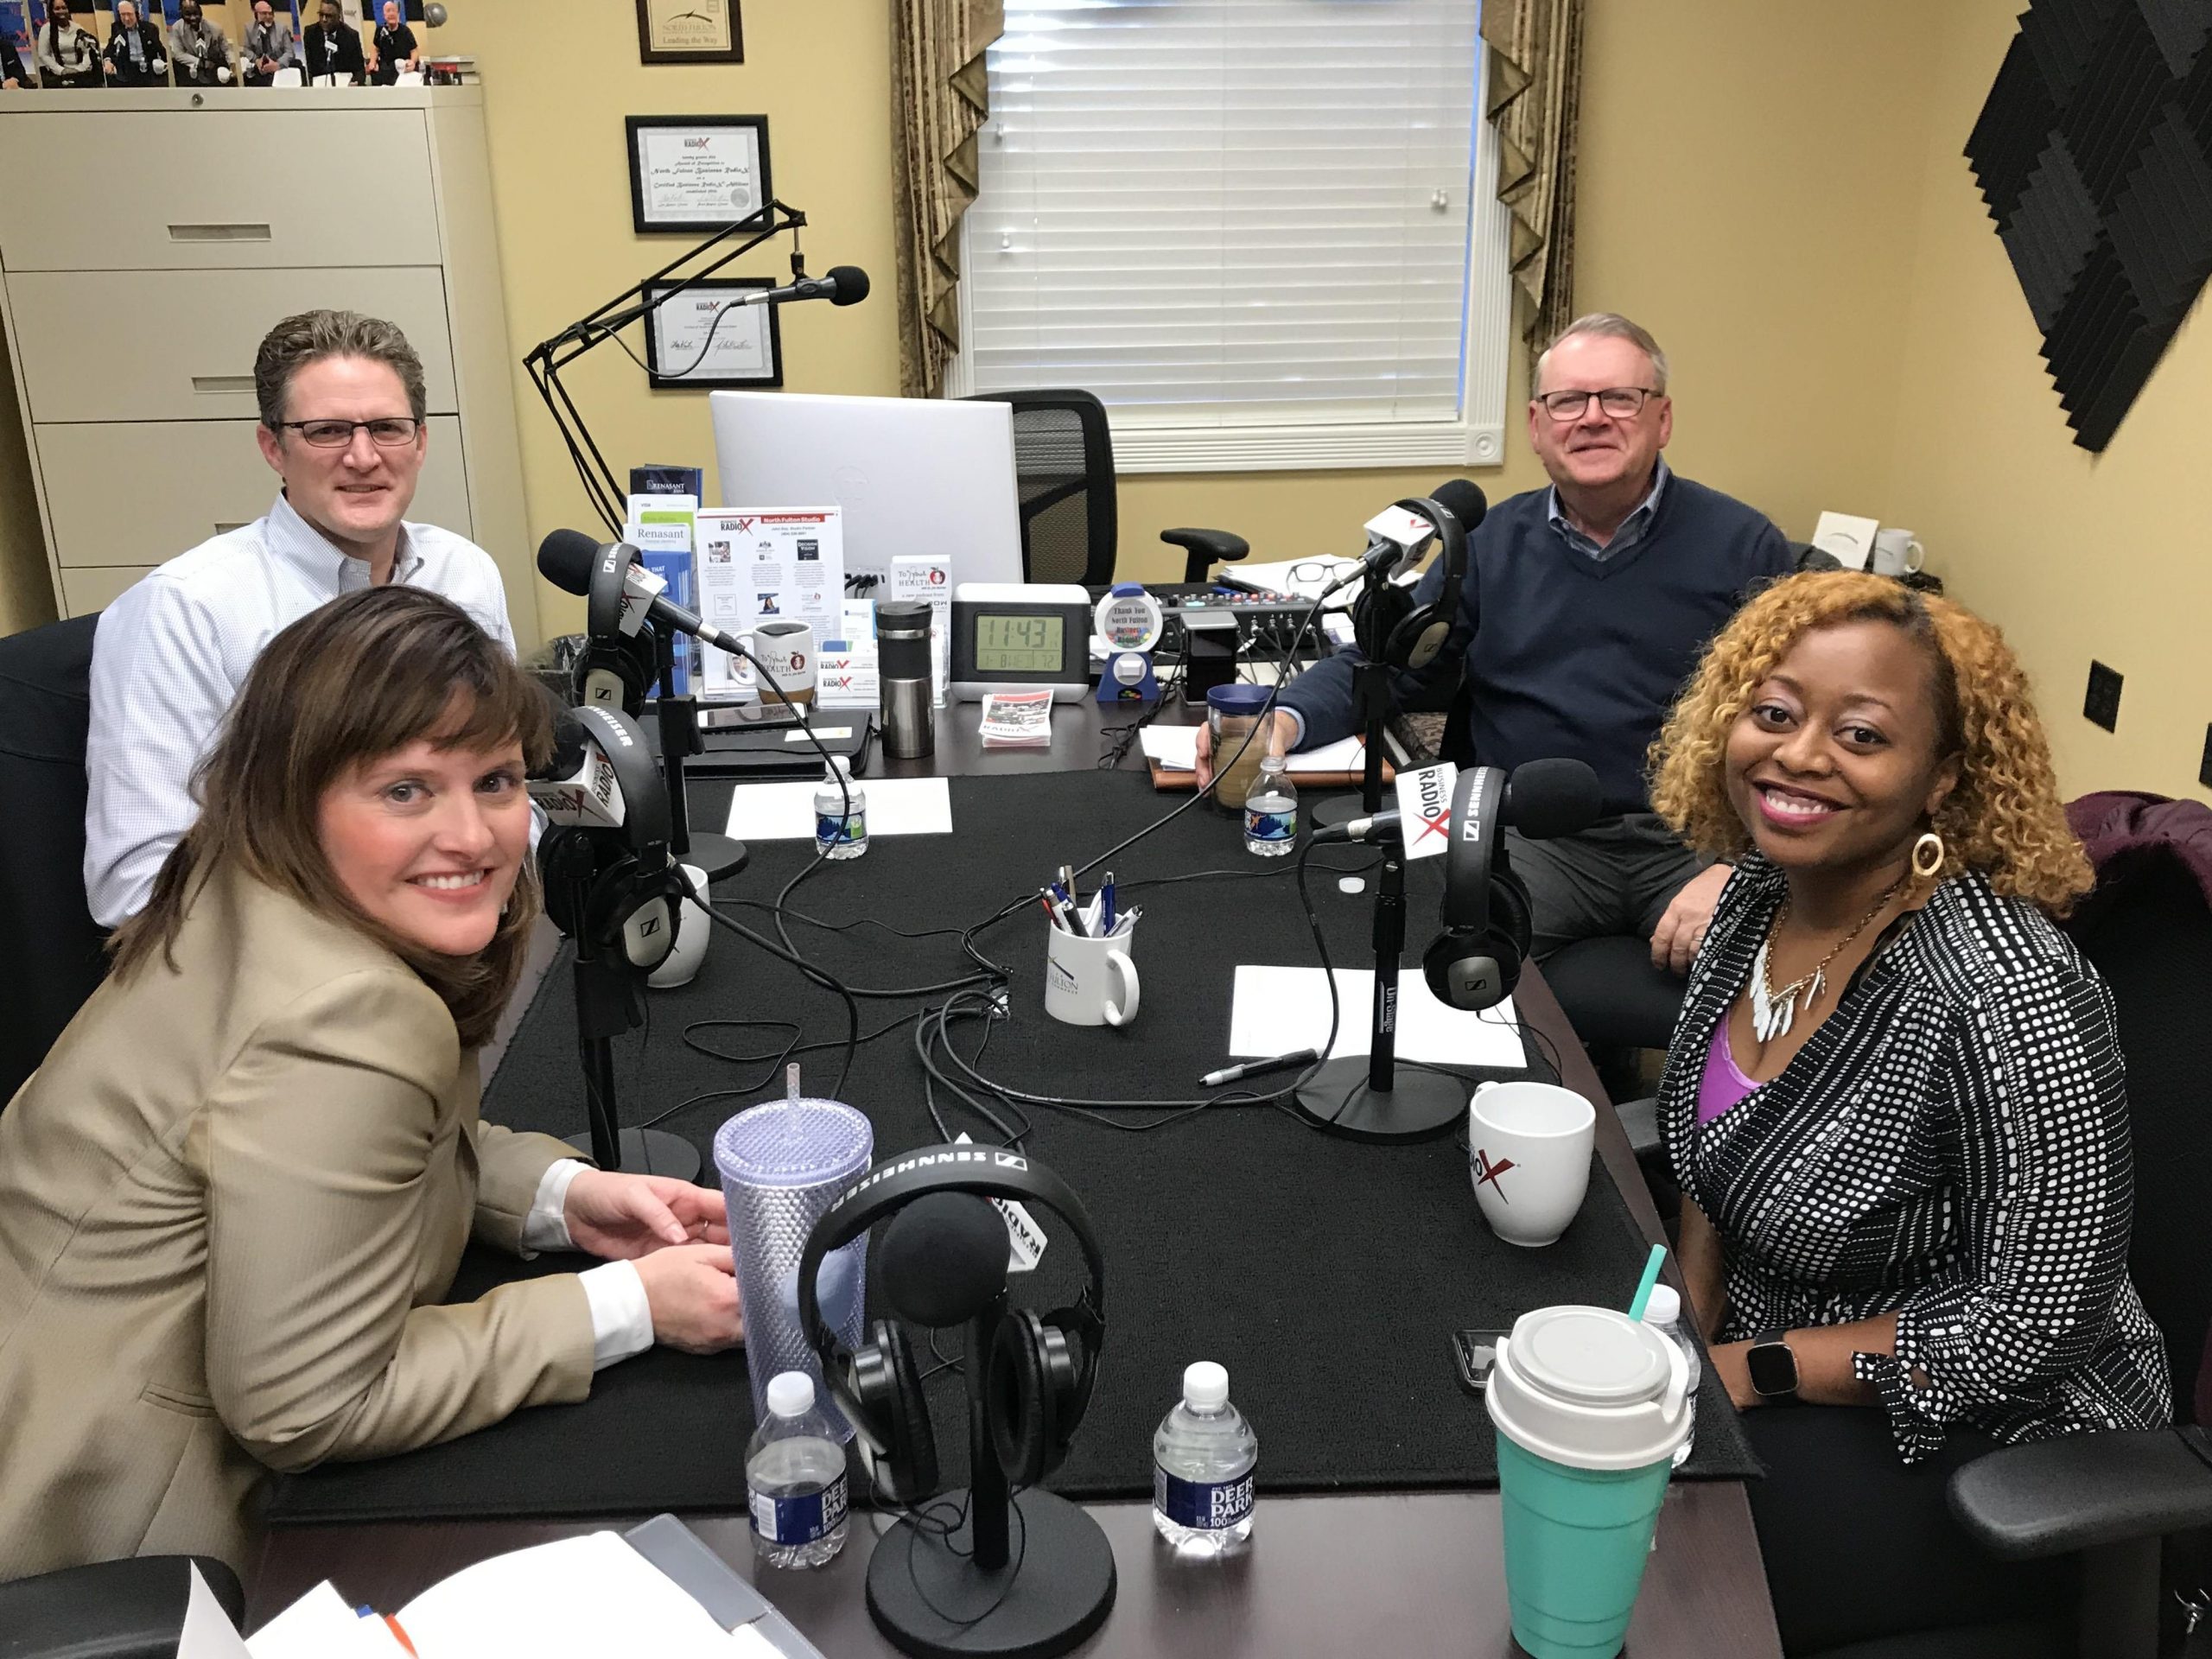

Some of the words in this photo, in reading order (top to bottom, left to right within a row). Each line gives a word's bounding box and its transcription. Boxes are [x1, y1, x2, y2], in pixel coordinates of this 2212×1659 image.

[703, 36, 717, 45] Way
[638, 528, 683, 538] Renasant
[988, 620, 1046, 648] 11:43
[1436, 767, 1447, 804] BUSINESS
[830, 1151, 987, 1213] SENNHEISER
[823, 1476, 847, 1509] DEE
[1211, 1475, 1253, 1503] DEER
[1211, 1489, 1253, 1517] PARK
[823, 1495, 847, 1525] PAR
